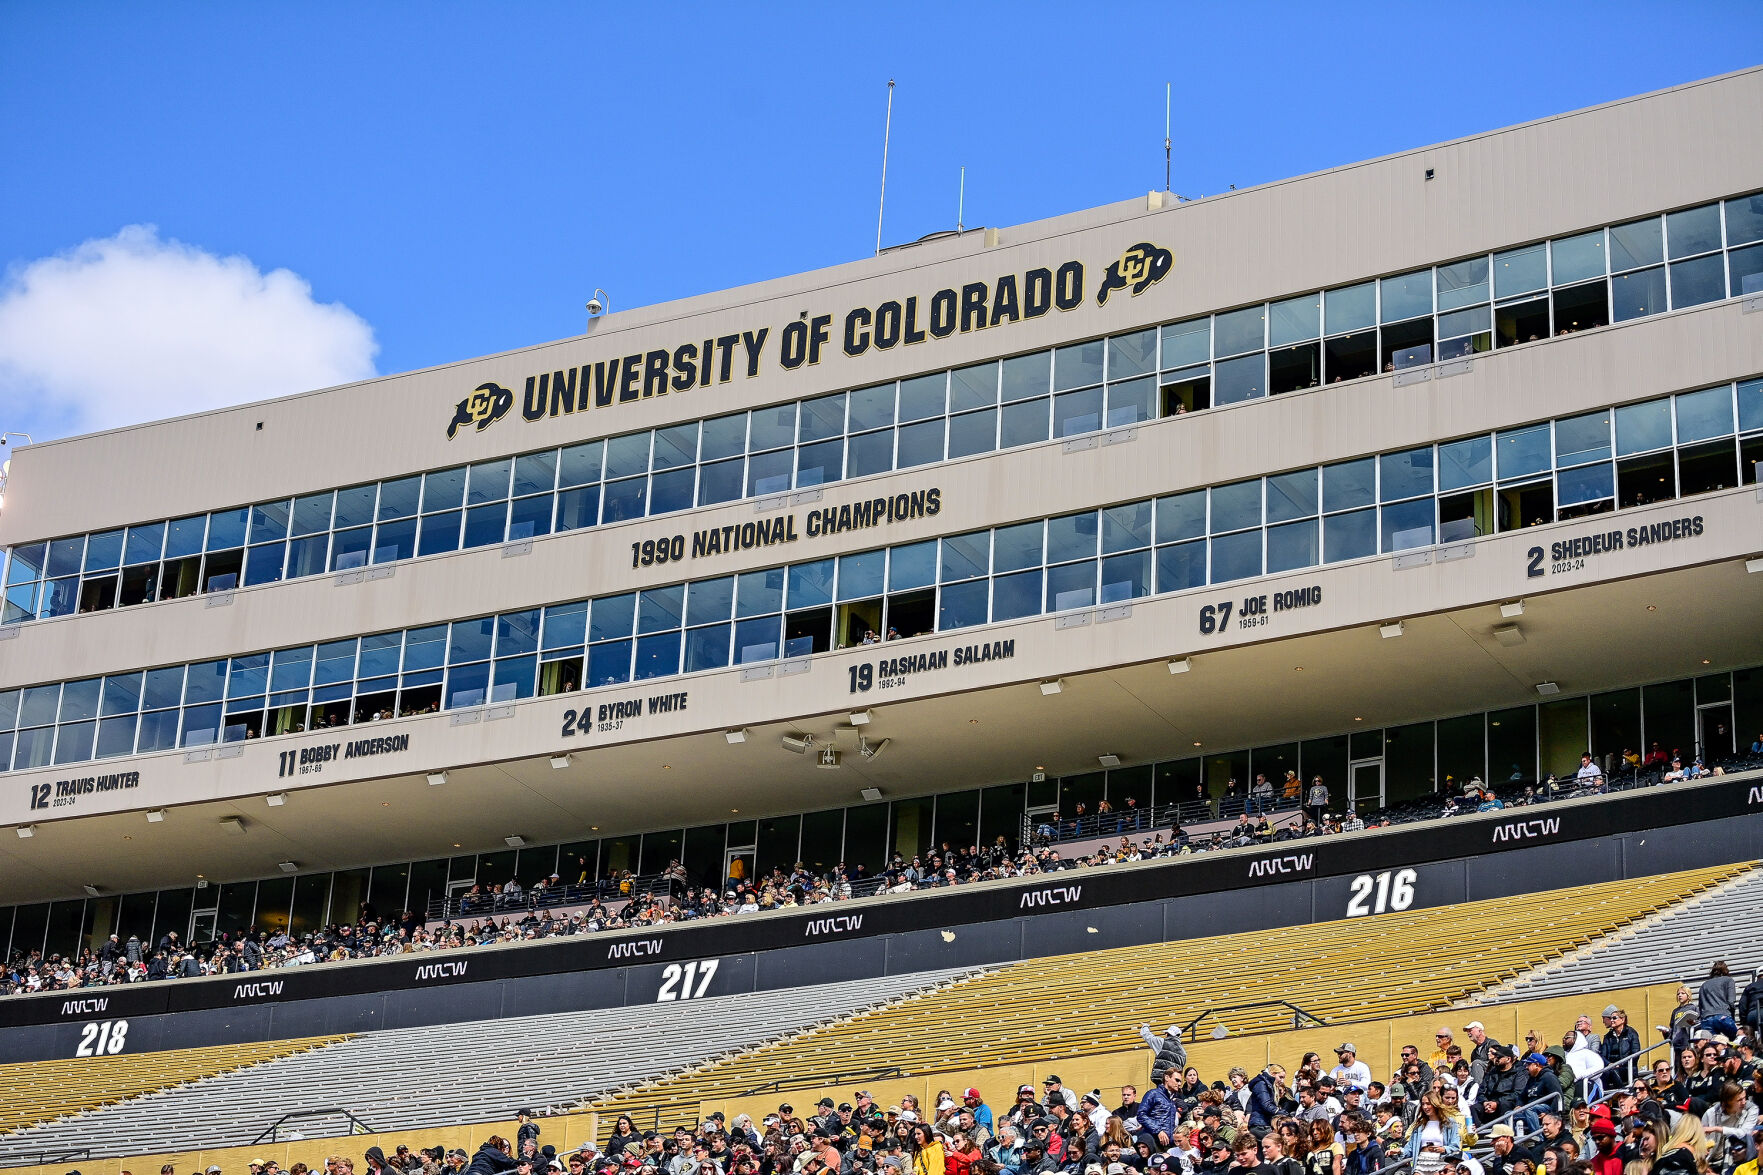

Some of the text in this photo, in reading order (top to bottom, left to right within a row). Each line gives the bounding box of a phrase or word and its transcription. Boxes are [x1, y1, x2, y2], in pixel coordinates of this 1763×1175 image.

[522, 260, 1085, 423] UNIVERSITY OF COLORADO
[632, 487, 942, 569] 1990 NATIONAL CHAMPIONS
[1527, 516, 1704, 579] 2 SHEDEUR SANDERS
[1551, 559, 1585, 574] 2023-24
[1199, 586, 1322, 635] 67 JOE ROMIG
[1239, 616, 1269, 629] 1959-61
[848, 639, 1015, 693] 19 RASHAAN SALAAM
[878, 677, 906, 690] 1992-94
[561, 692, 688, 737] 24 BYRON WHITE
[597, 720, 624, 733] 1935-37
[279, 734, 410, 777] 11 BOBBY ANDERSON
[30, 771, 140, 810] 12 TRAVIS HUNTER
[53, 797, 76, 808] 2023-24
[1346, 868, 1417, 919] 216
[656, 958, 720, 1003] 217
[75, 1019, 129, 1058] 218
